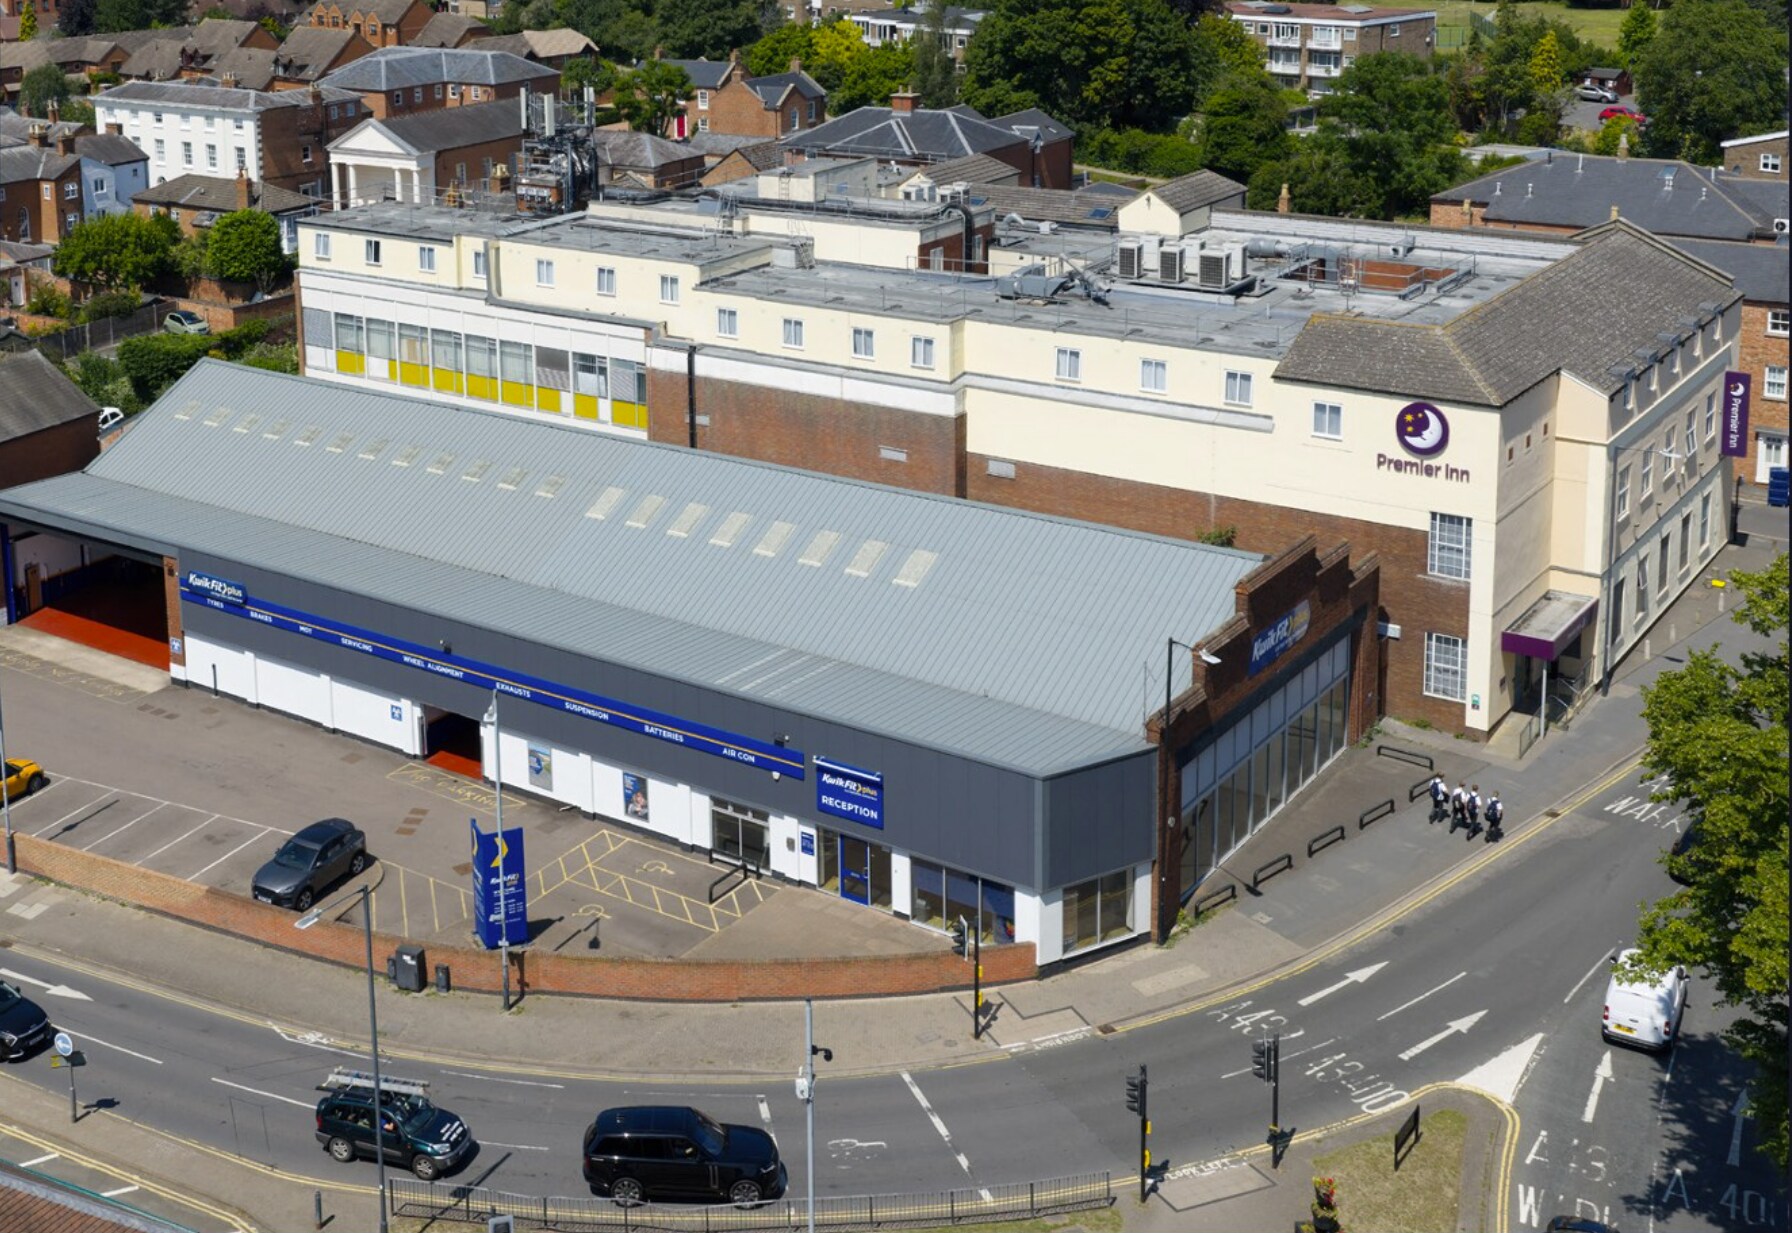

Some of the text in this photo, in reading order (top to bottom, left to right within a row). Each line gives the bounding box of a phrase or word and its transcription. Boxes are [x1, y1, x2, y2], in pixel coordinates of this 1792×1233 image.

[1729, 397, 1742, 448] Premier Inn
[1377, 453, 1470, 483] Premier Inn
[250, 610, 273, 622] BRAKES
[299, 625, 312, 634] MOT
[341, 637, 373, 652] SERVICING
[402, 655, 425, 668] WHEEL
[427, 663, 464, 679] ALIGNMENT
[496, 682, 531, 698] EXHAUSTS
[565, 701, 609, 721] SUSPENSION
[644, 725, 684, 743] BATTERIES
[722, 747, 736, 758] AIR
[737, 751, 755, 763] CON
[821, 795, 878, 820] RECEPTION
